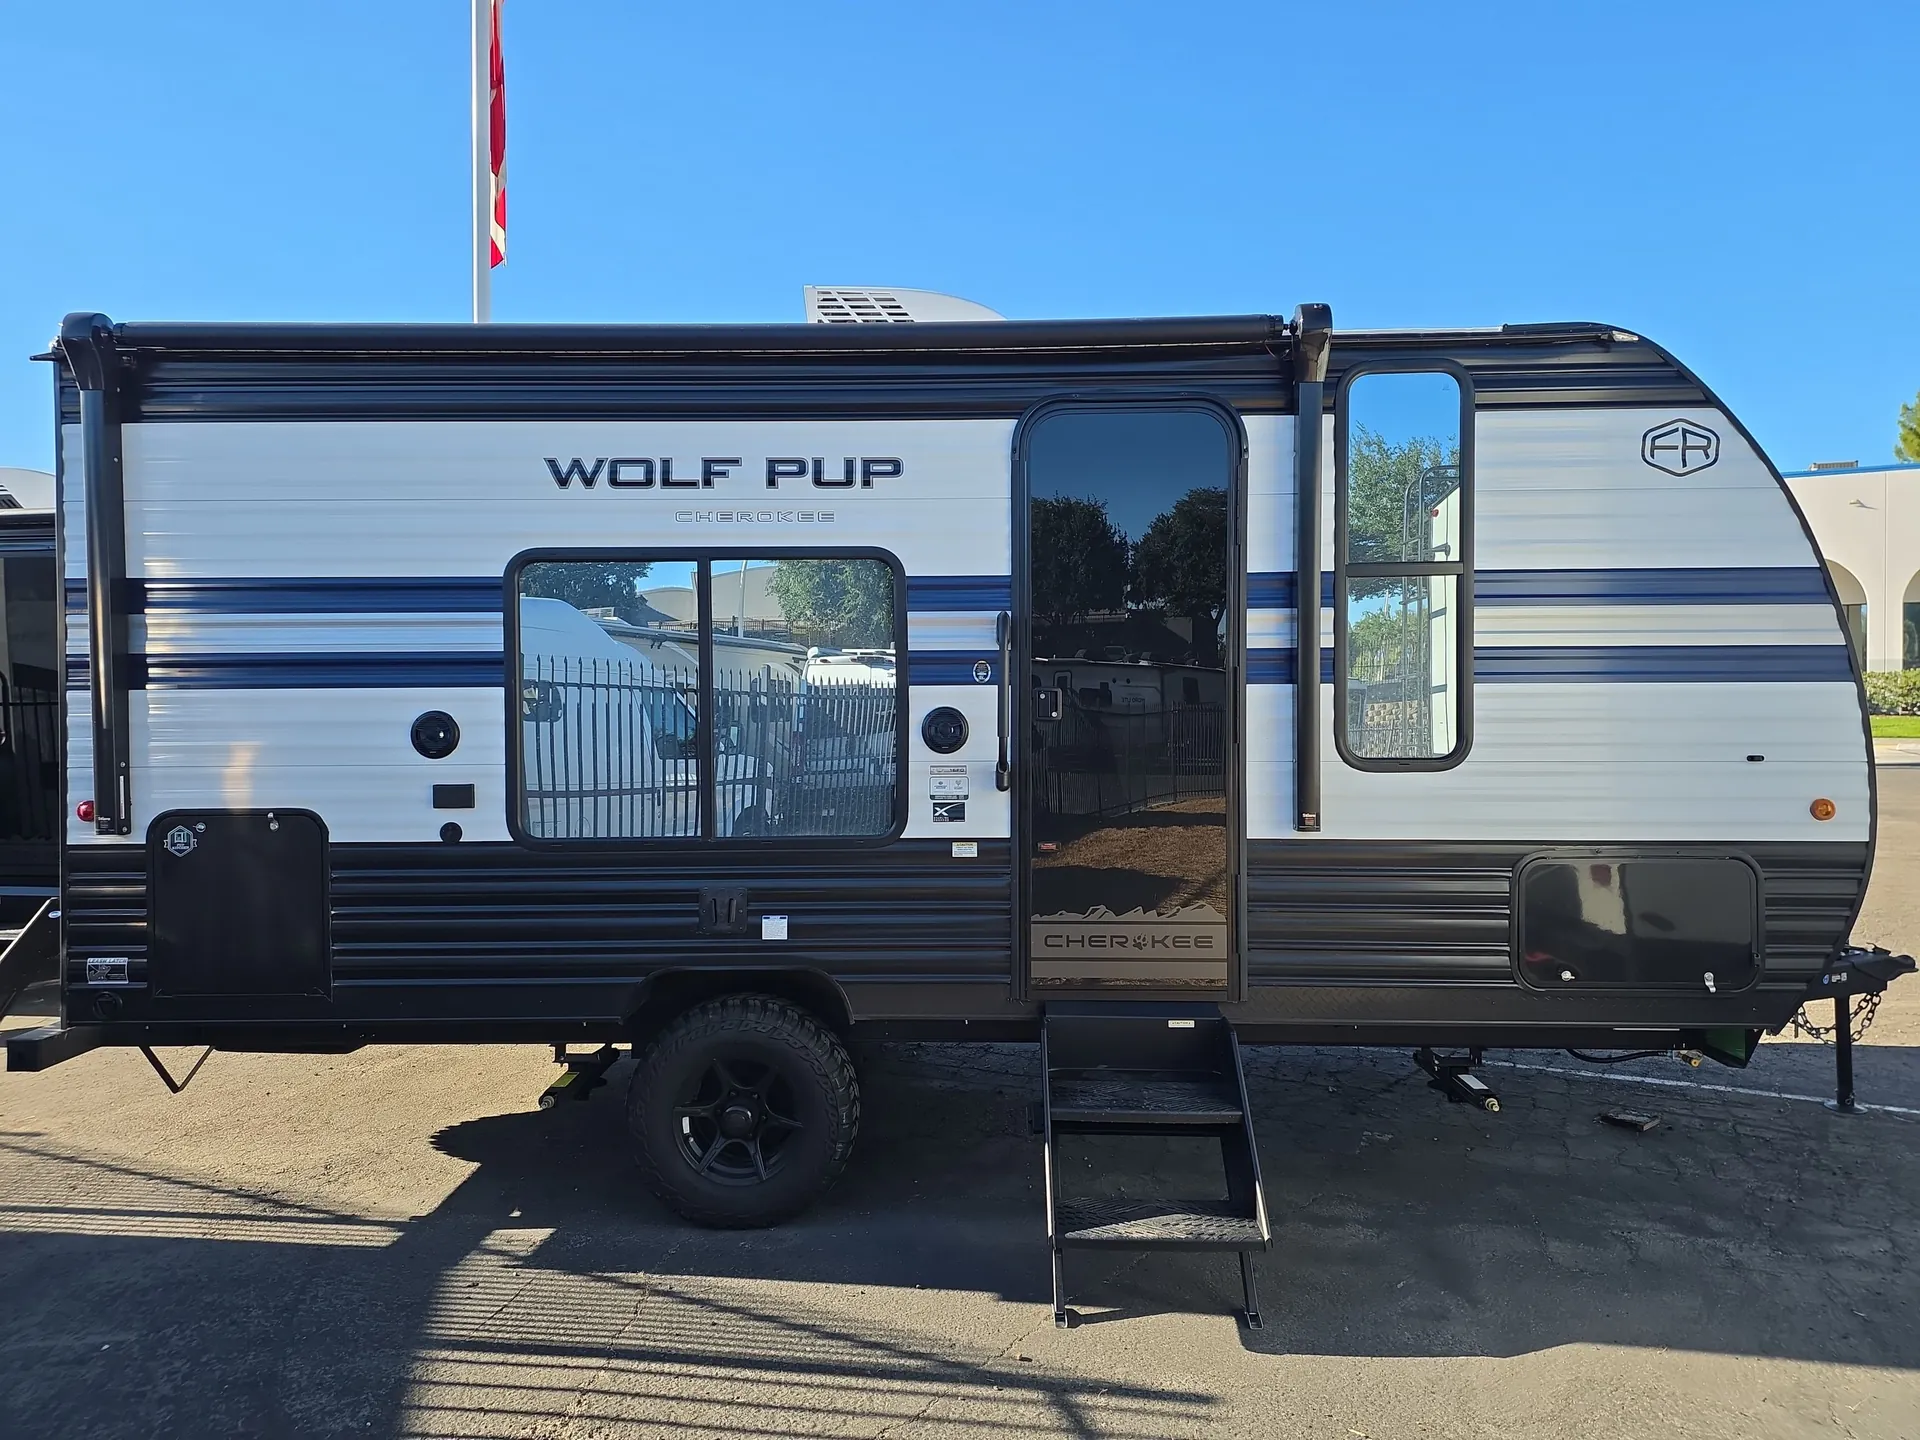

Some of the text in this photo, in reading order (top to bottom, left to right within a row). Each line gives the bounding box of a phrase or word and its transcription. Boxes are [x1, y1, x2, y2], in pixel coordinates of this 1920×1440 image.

[1649, 426, 1712, 469] FR
[543, 456, 904, 490] WOLF PUP
[674, 509, 836, 523] CHEROKEE
